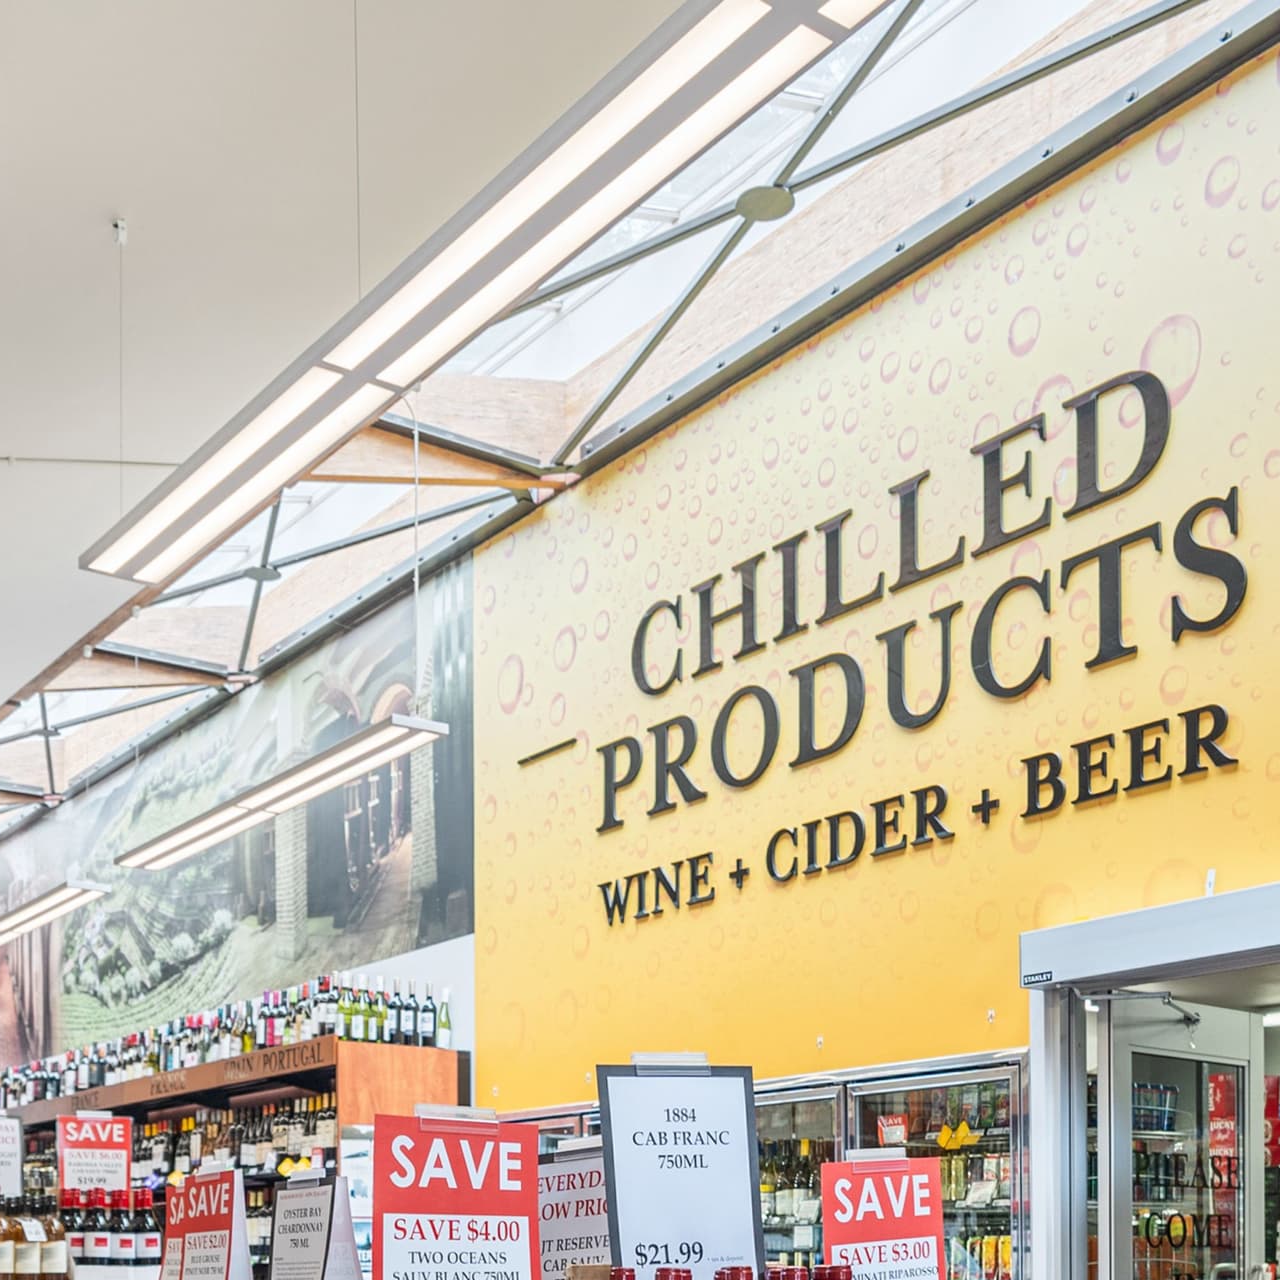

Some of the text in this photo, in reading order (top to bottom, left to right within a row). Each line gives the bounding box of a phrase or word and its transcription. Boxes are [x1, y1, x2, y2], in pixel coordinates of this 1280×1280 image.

[630, 370, 1172, 698] CHILLED
[595, 486, 1248, 834] PRODUCTS
[597, 703, 1239, 927] WINE + CIDER + BEER
[1024, 973, 1052, 984] STANLEY
[663, 1108, 697, 1122] 1884
[65, 1122, 125, 1143] SAVE
[632, 1130, 730, 1146] CAB FRANC
[389, 1134, 522, 1191] SAVE
[658, 1154, 709, 1169] 750ML
[77, 1176, 107, 1185] $19.99
[188, 1182, 230, 1219] SAVE
[833, 1174, 931, 1223] SAVE
[283, 1207, 322, 1220] OYSTER BAY
[277, 1222, 323, 1235] CHARDONNAY
[393, 1218, 520, 1242] SAVE $4.00
[186, 1233, 227, 1250] SAVE $2.00
[289, 1238, 309, 1248] 750 ML
[407, 1251, 507, 1264] TWO OCEANS
[635, 1241, 704, 1266] $21.99
[543, 1259, 567, 1272] CAB
